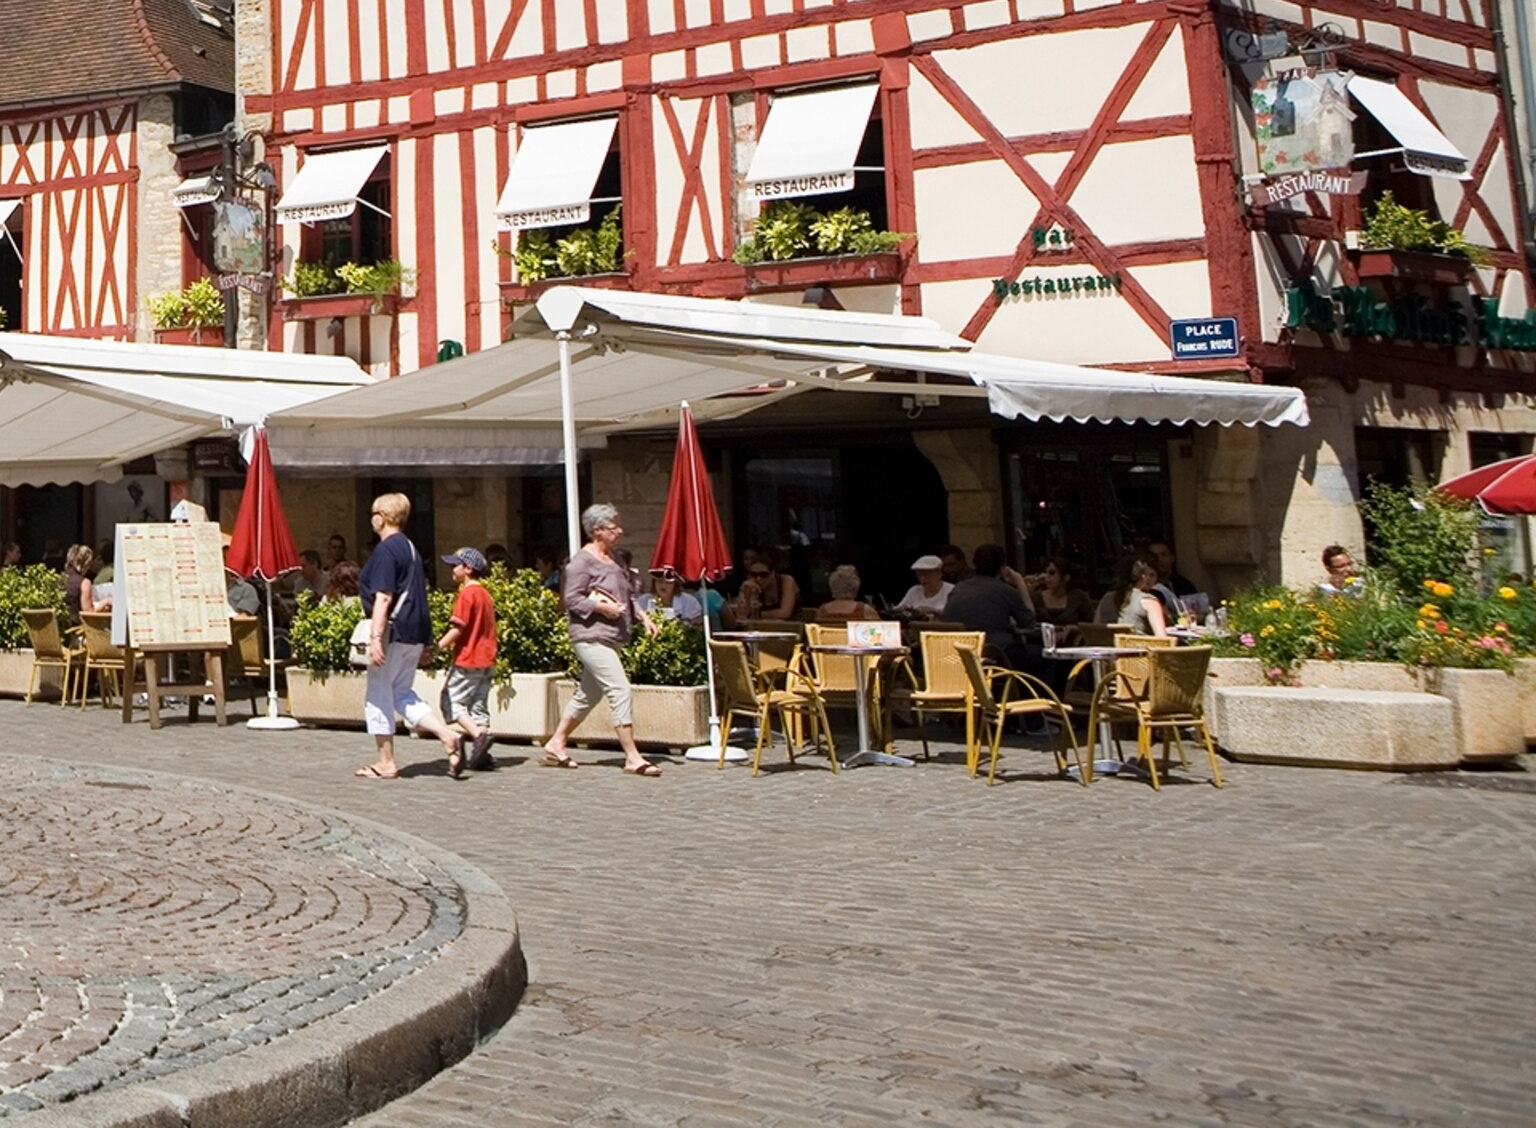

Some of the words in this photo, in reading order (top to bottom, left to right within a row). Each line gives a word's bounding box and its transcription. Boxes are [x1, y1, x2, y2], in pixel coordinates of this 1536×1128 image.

[754, 173, 847, 196] RESTAURANT
[1267, 173, 1353, 203] RESTAURANT
[285, 202, 349, 219] RESTAURANT
[505, 206, 582, 226] RESTAURANT
[1032, 227, 1075, 246] Bar
[219, 274, 264, 294] RESTAURANT
[992, 272, 1122, 297] Restaurant
[1185, 324, 1222, 336] PLACE
[1209, 338, 1234, 350] RUDE
